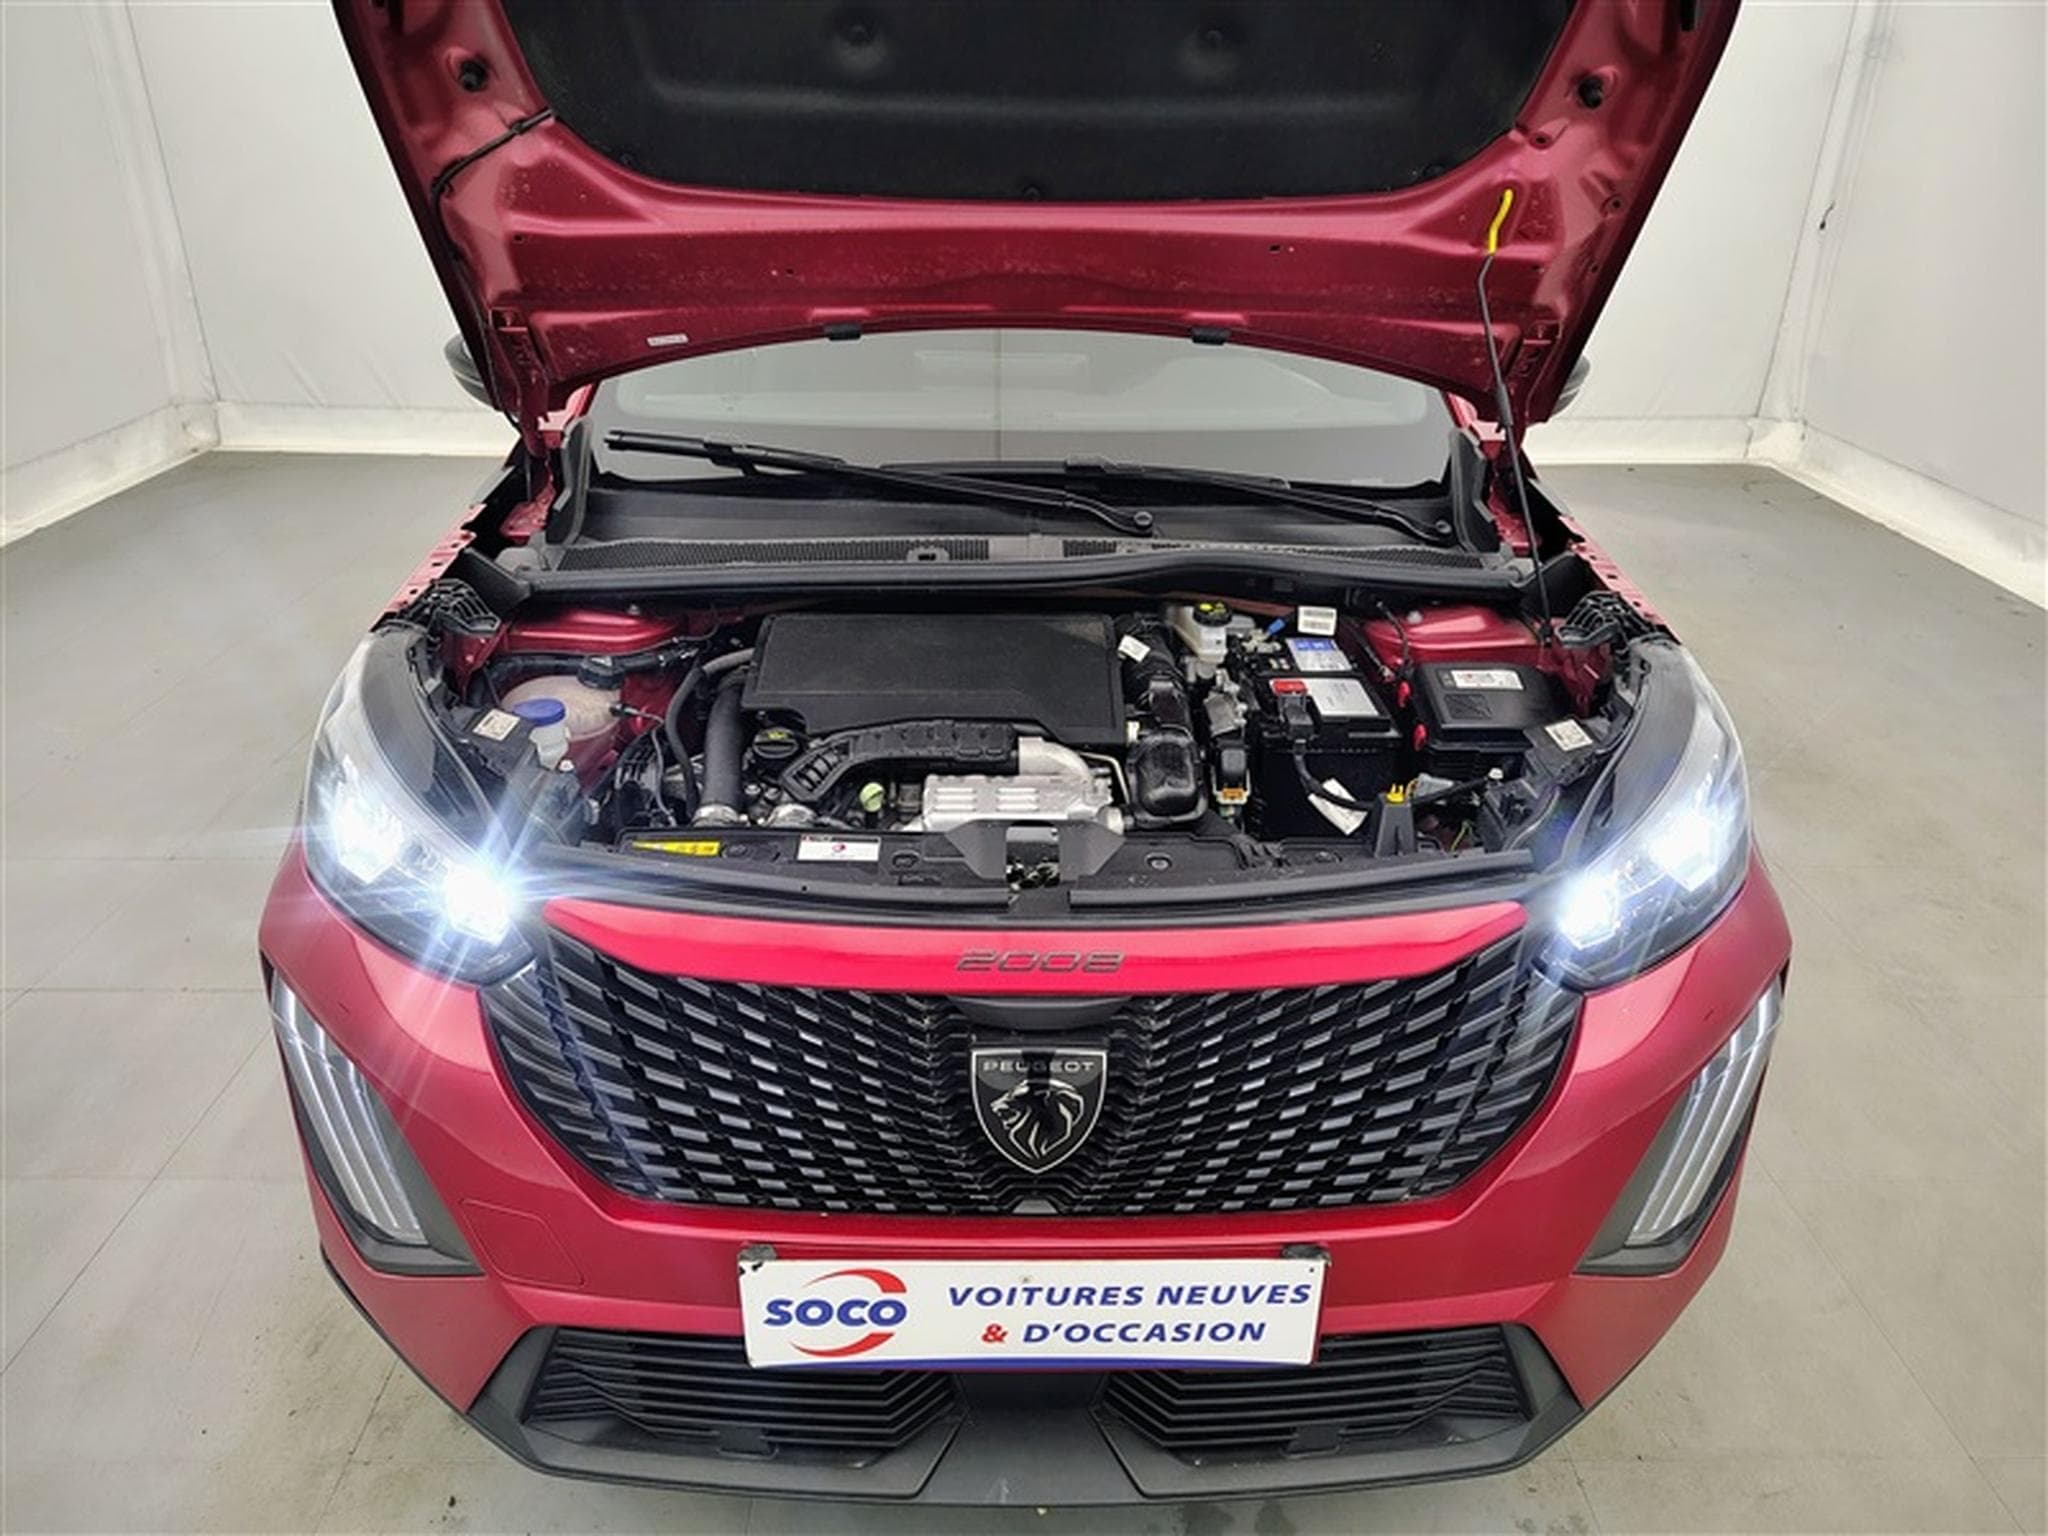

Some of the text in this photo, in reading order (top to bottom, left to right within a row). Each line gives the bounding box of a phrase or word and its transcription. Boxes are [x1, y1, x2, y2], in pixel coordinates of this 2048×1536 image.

[957, 950, 1126, 972] 2008
[982, 1059, 1095, 1073] PEUGEOT
[949, 1283, 1312, 1307] VOITURES NEUVES
[763, 1298, 908, 1328] SOCO
[981, 1321, 1266, 1345] & D’OCCASION
